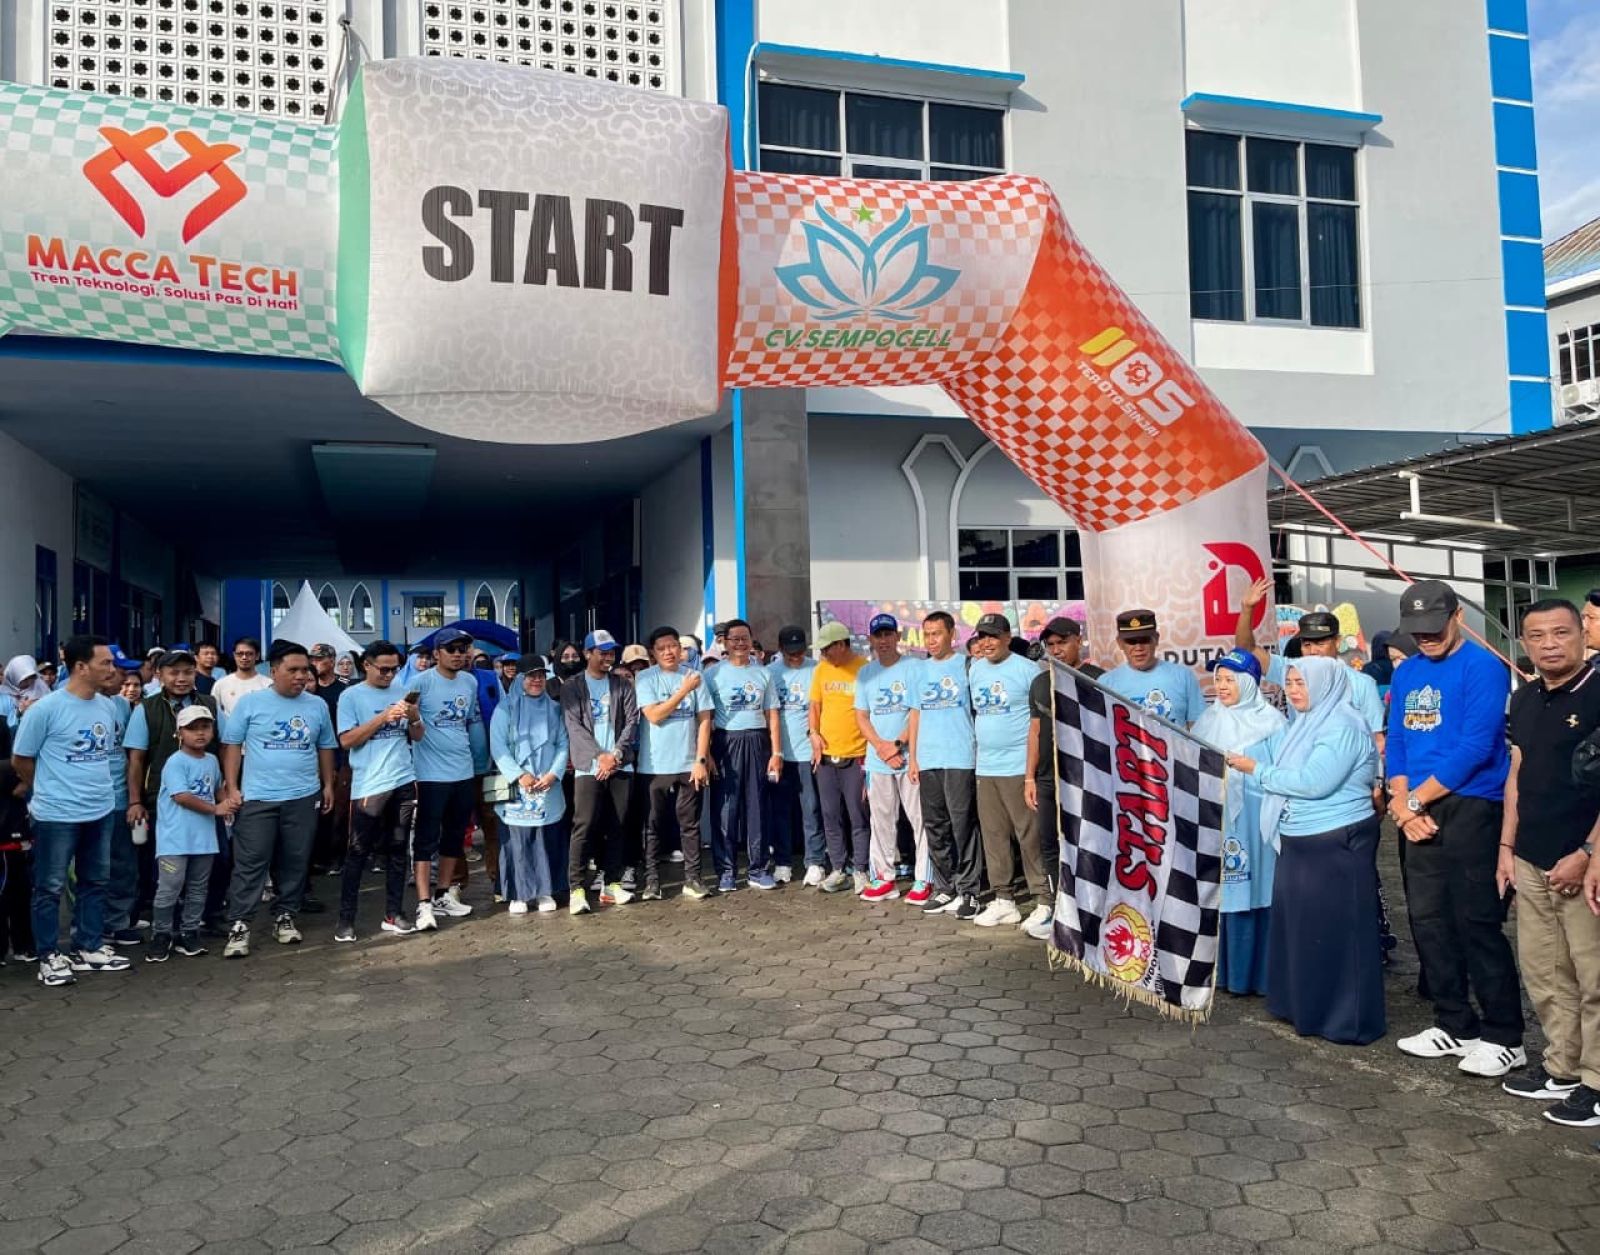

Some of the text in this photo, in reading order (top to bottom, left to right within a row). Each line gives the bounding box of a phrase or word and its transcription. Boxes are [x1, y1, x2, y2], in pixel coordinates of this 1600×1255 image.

[27, 235, 298, 296] MACCA TECH
[421, 185, 685, 296] START
[31, 271, 70, 285] Tren
[164, 287, 211, 301] Solusi
[215, 293, 243, 305] Pas
[247, 296, 262, 306] Di
[267, 299, 298, 310] Hati
[1164, 647, 1229, 666] DUTA
[1112, 703, 1170, 901] START
